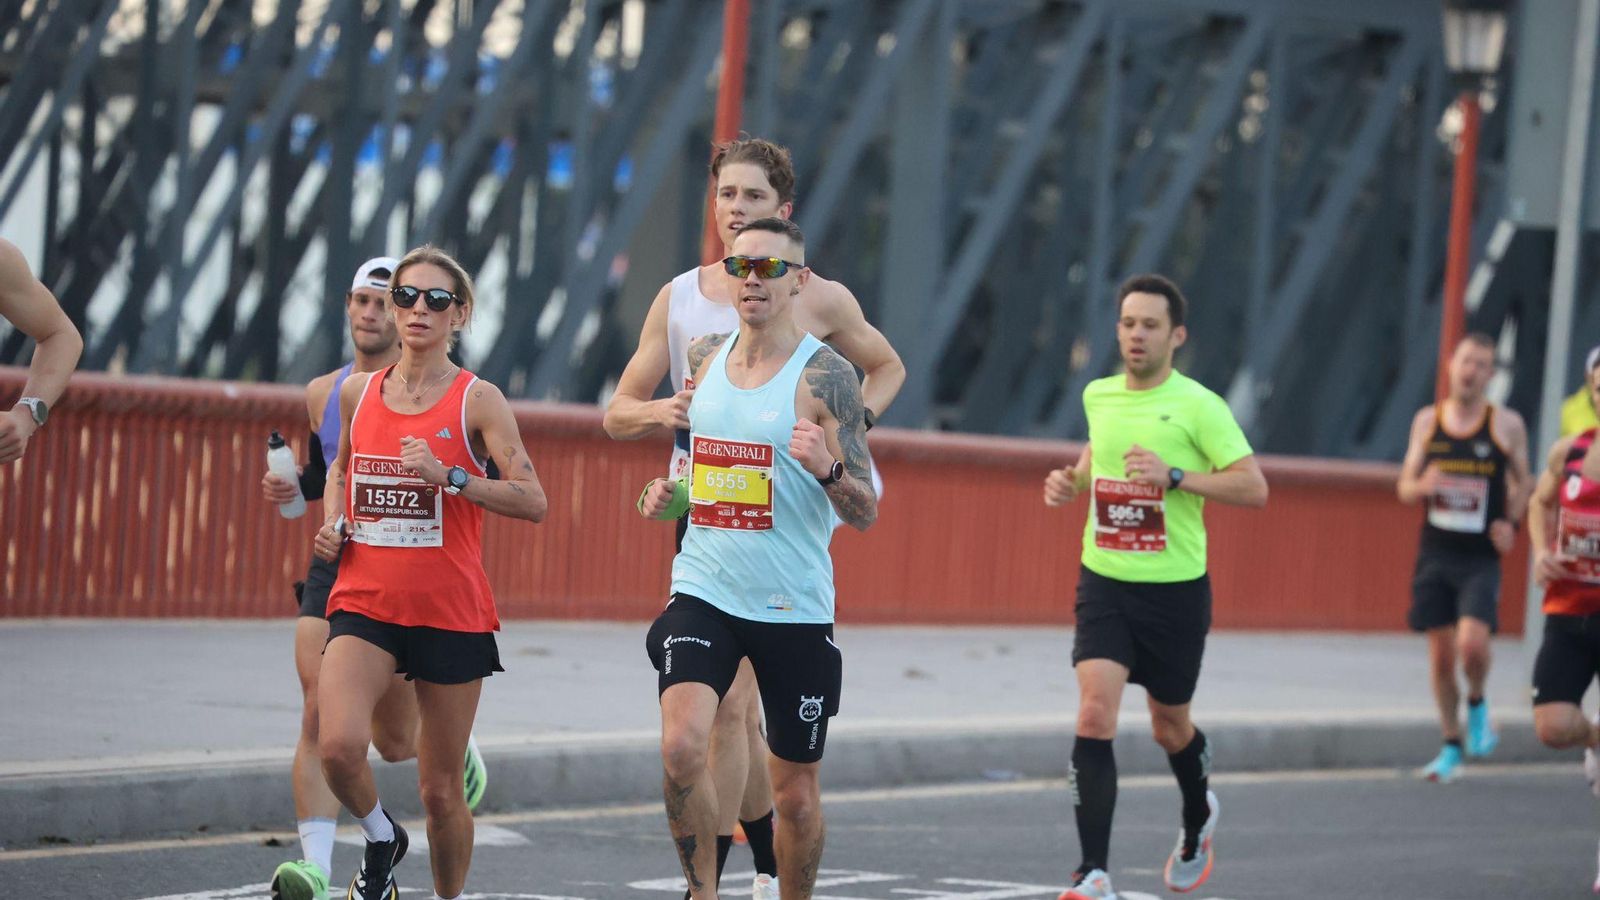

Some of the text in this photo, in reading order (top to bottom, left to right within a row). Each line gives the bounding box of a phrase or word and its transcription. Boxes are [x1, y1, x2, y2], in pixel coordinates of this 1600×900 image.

[708, 443, 766, 460] GENERALI
[705, 471, 748, 490] 6555
[366, 489, 419, 507] 15572
[386, 507, 428, 515] RESPUBLIKOS
[1107, 504, 1145, 521] 5064
[670, 636, 711, 648] mondi
[808, 722, 819, 750] FUSION
